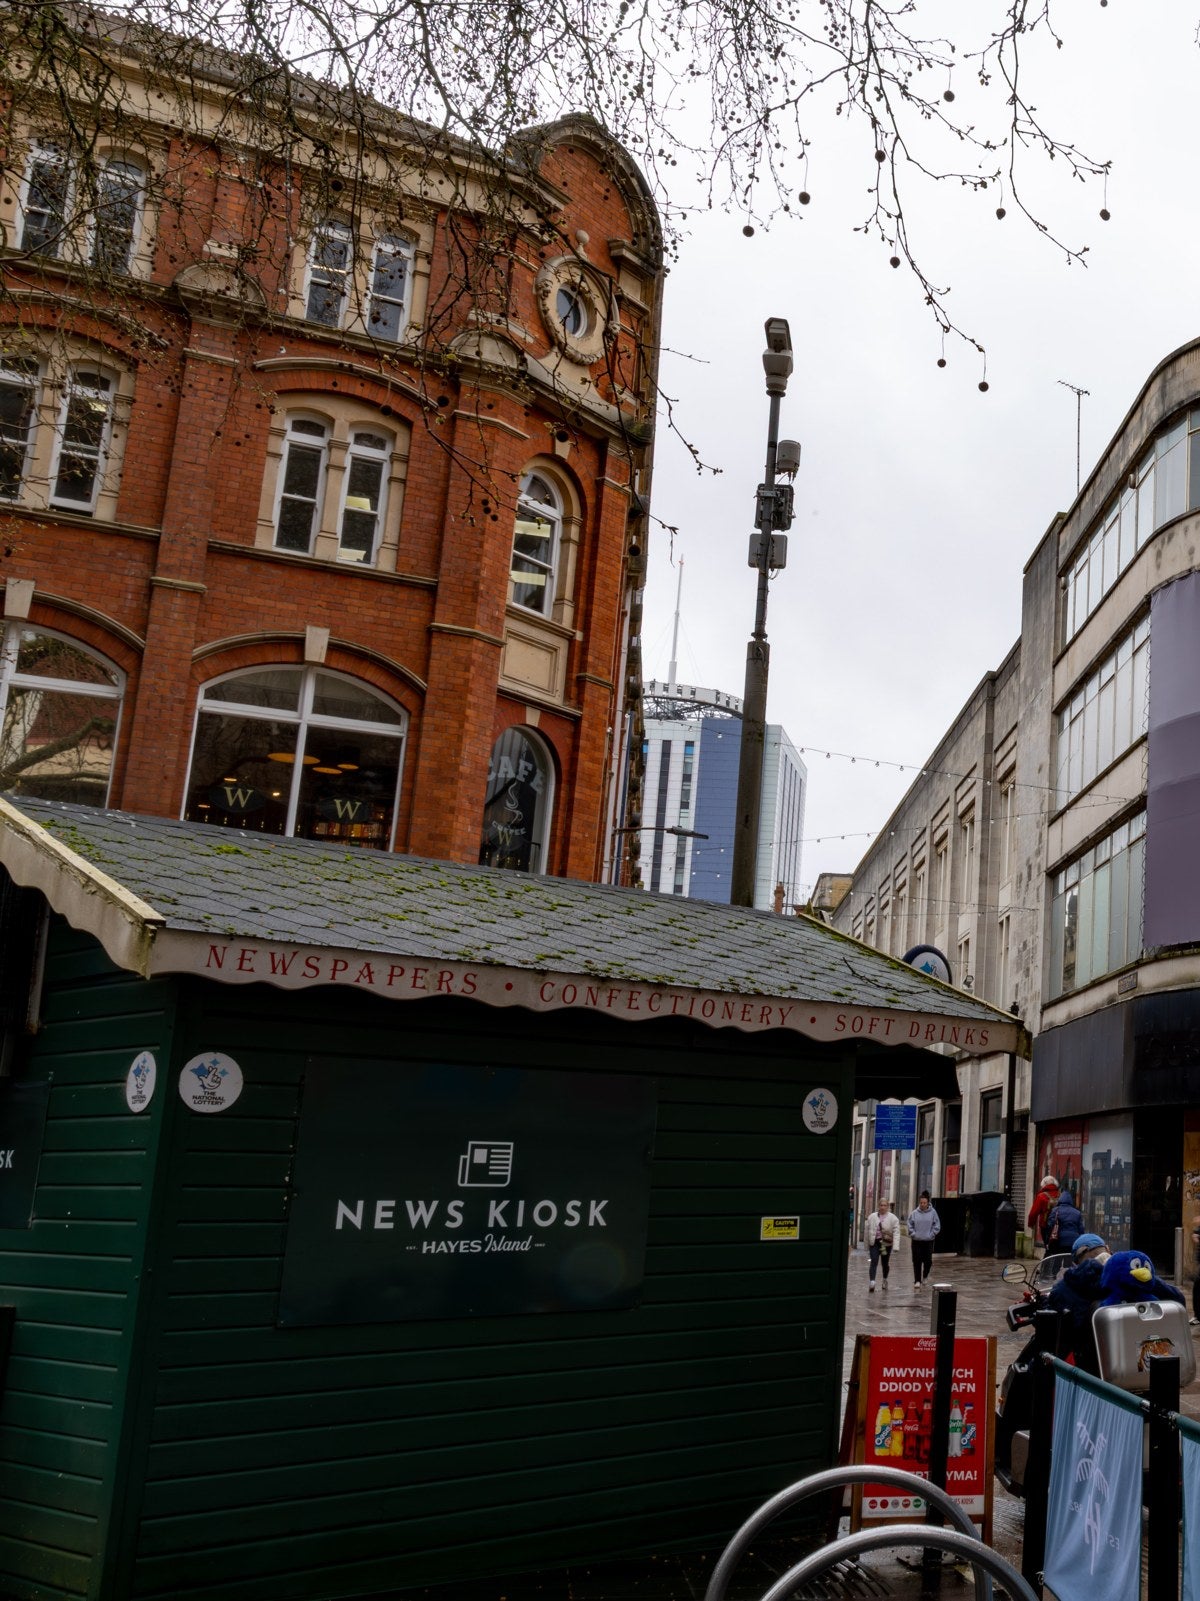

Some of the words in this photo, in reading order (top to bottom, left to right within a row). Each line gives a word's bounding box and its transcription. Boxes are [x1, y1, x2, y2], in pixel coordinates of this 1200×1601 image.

[224, 786, 254, 808] W
[334, 799, 362, 820] W
[205, 944, 478, 995] NEWSPAPERS
[540, 981, 797, 1027] CONFECTIONERY
[834, 1014, 895, 1036] SOFT
[909, 1020, 992, 1047] DRINKS
[335, 1200, 465, 1230] NEWS
[487, 1199, 609, 1228] KIOSK
[422, 1239, 483, 1254] HAYES
[484, 1233, 534, 1253] Island
[883, 1367, 973, 1379] MWYNHCH
[879, 1382, 922, 1393] DDIOD
[925, 1382, 976, 1393] YAFN
[946, 1470, 977, 1481] YMA!
